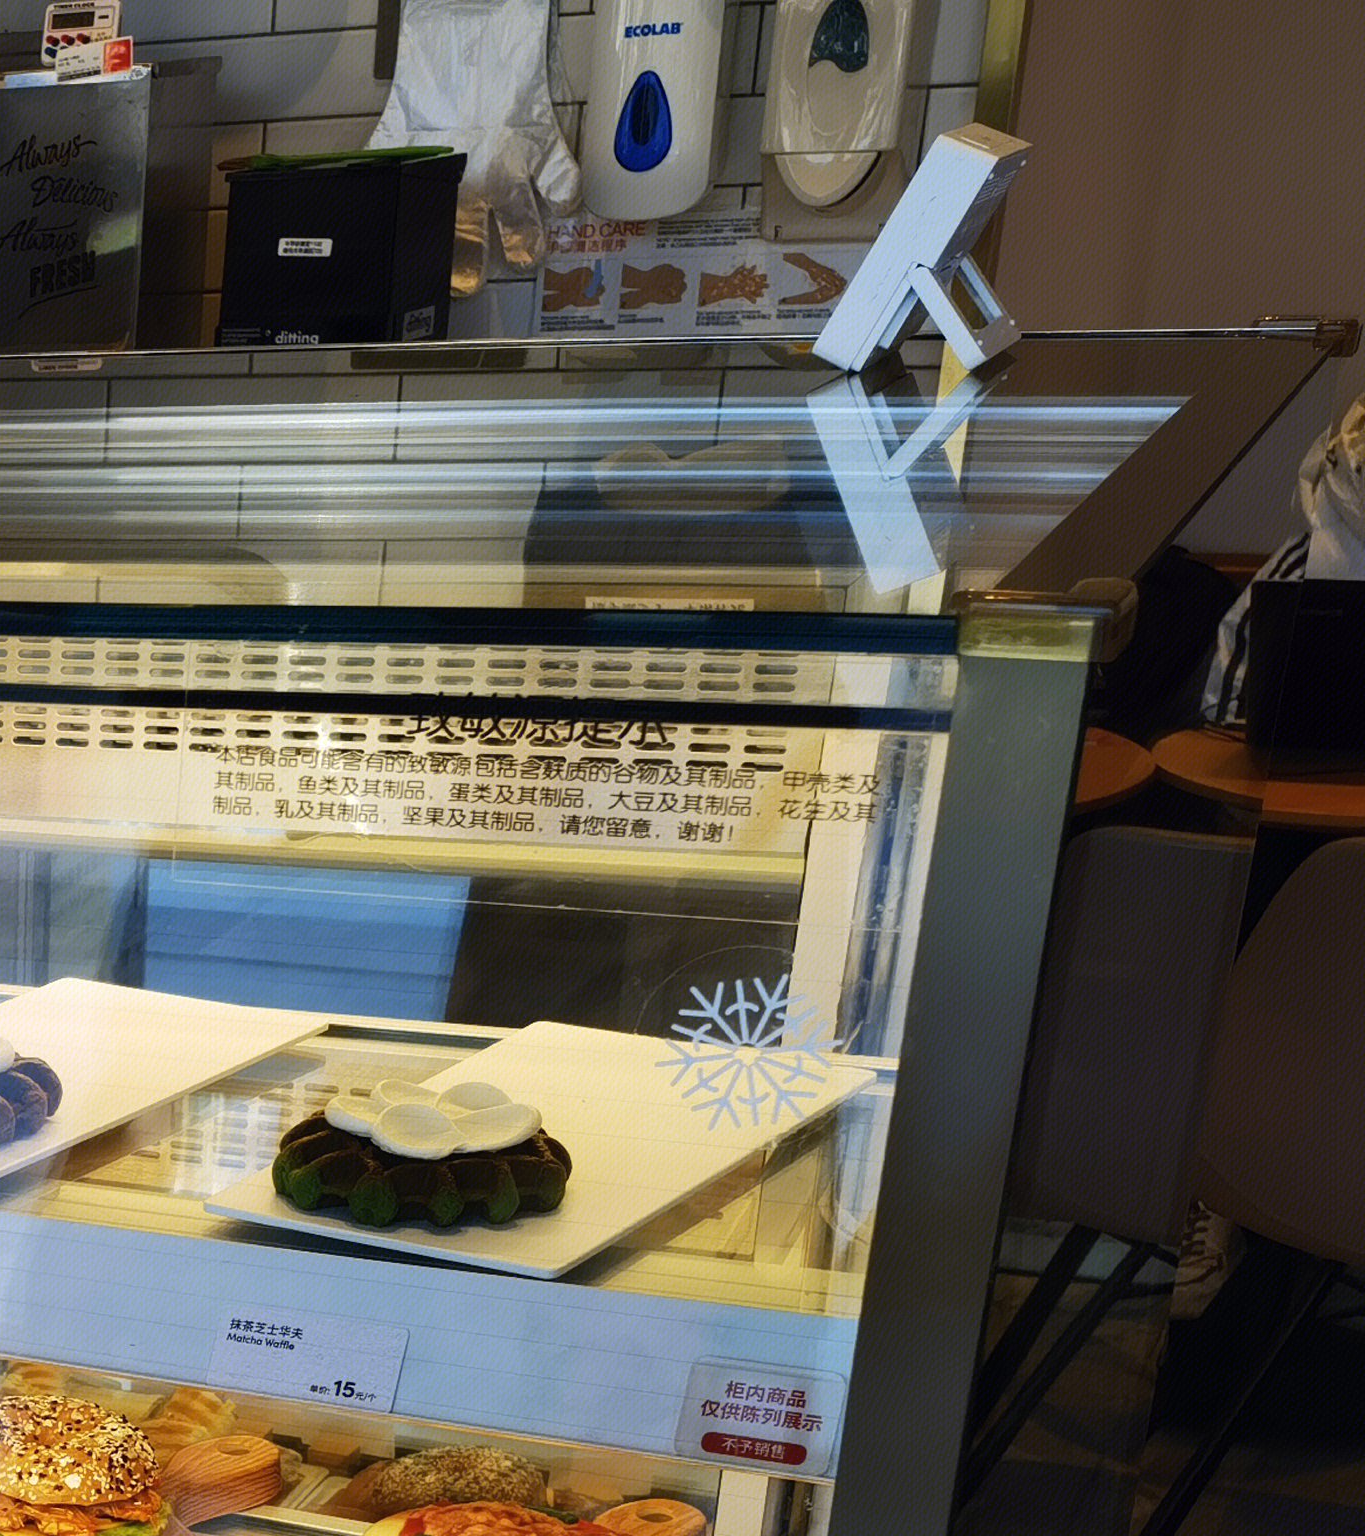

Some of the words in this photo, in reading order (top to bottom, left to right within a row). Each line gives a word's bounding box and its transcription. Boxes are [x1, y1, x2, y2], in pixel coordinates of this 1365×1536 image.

[625, 22, 681, 38] ECOLAB
[31, 175, 118, 212] Delicious
[549, 223, 595, 240] HAND
[599, 221, 646, 238] CARE
[30, 251, 96, 297] FRESH
[275, 330, 319, 344] ditting
[229, 1318, 303, 1340] 抹茶芝士华夫
[226, 1332, 262, 1346] Matcha
[265, 1338, 295, 1350] Waffle
[725, 1380, 807, 1408] 柜内商品
[701, 1399, 823, 1432] 仅供陈列展示
[721, 1436, 786, 1460] 不予销售
